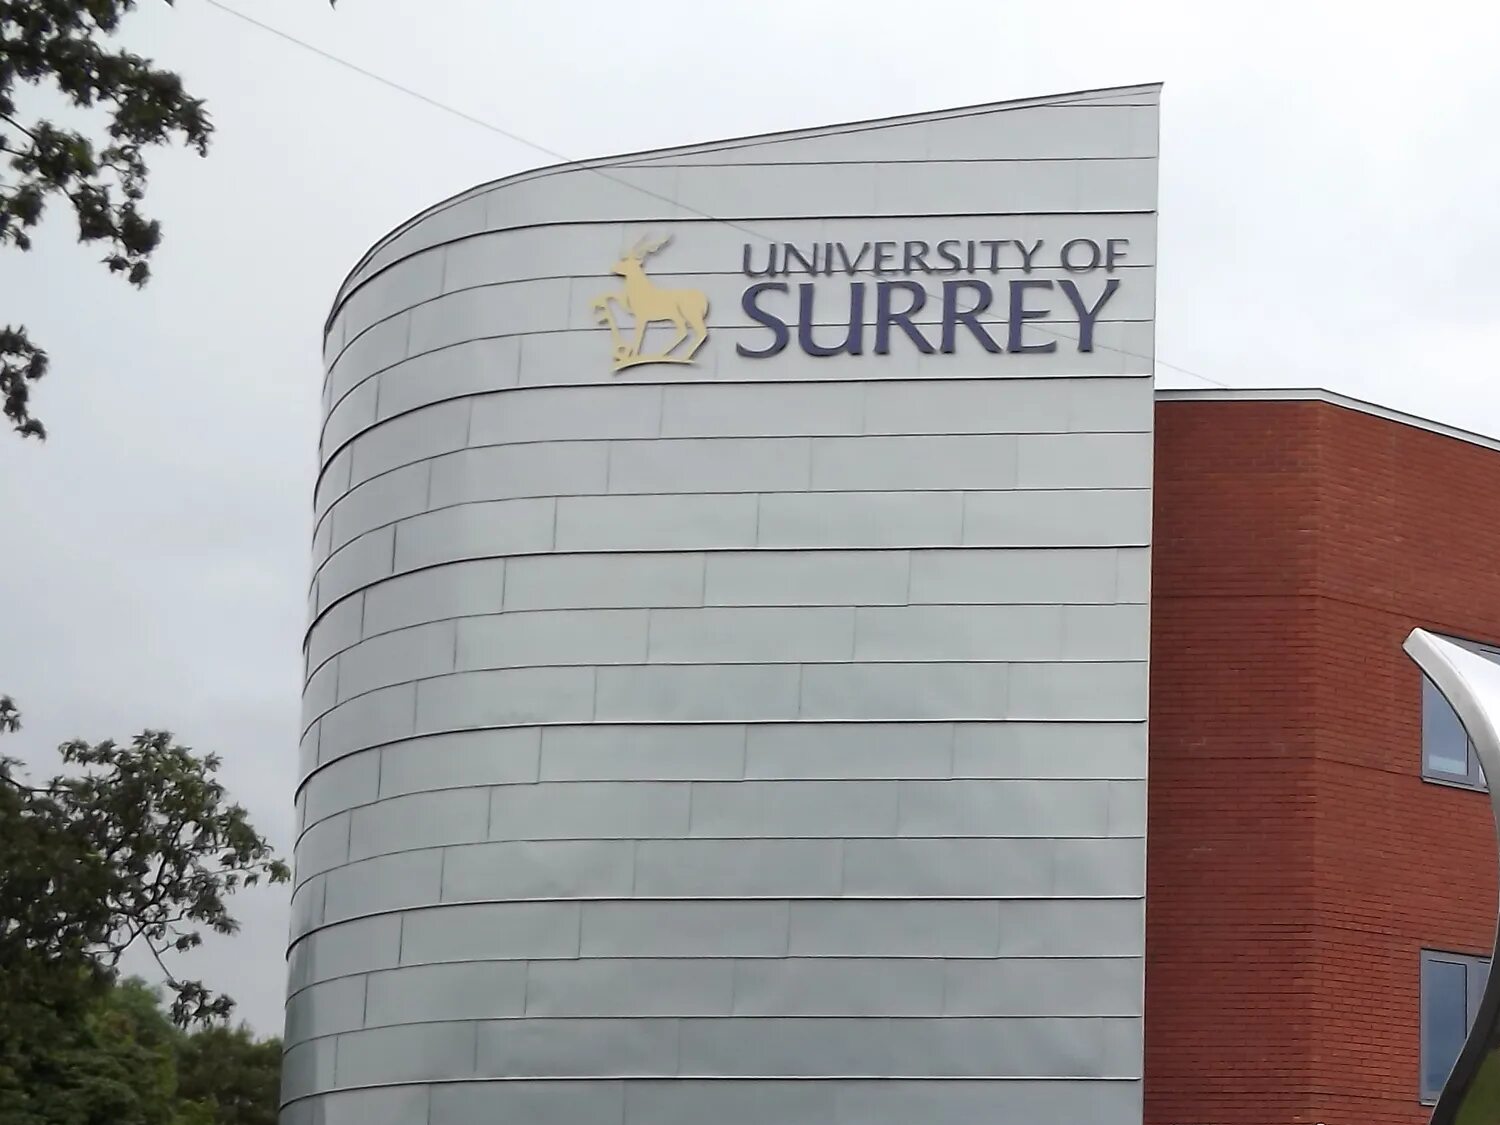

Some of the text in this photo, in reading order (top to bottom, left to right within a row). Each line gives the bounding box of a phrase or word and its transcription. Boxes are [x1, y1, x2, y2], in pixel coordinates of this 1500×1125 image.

[742, 237, 1130, 278] UNIVERSITY OF
[736, 278, 1120, 360] SURREY
